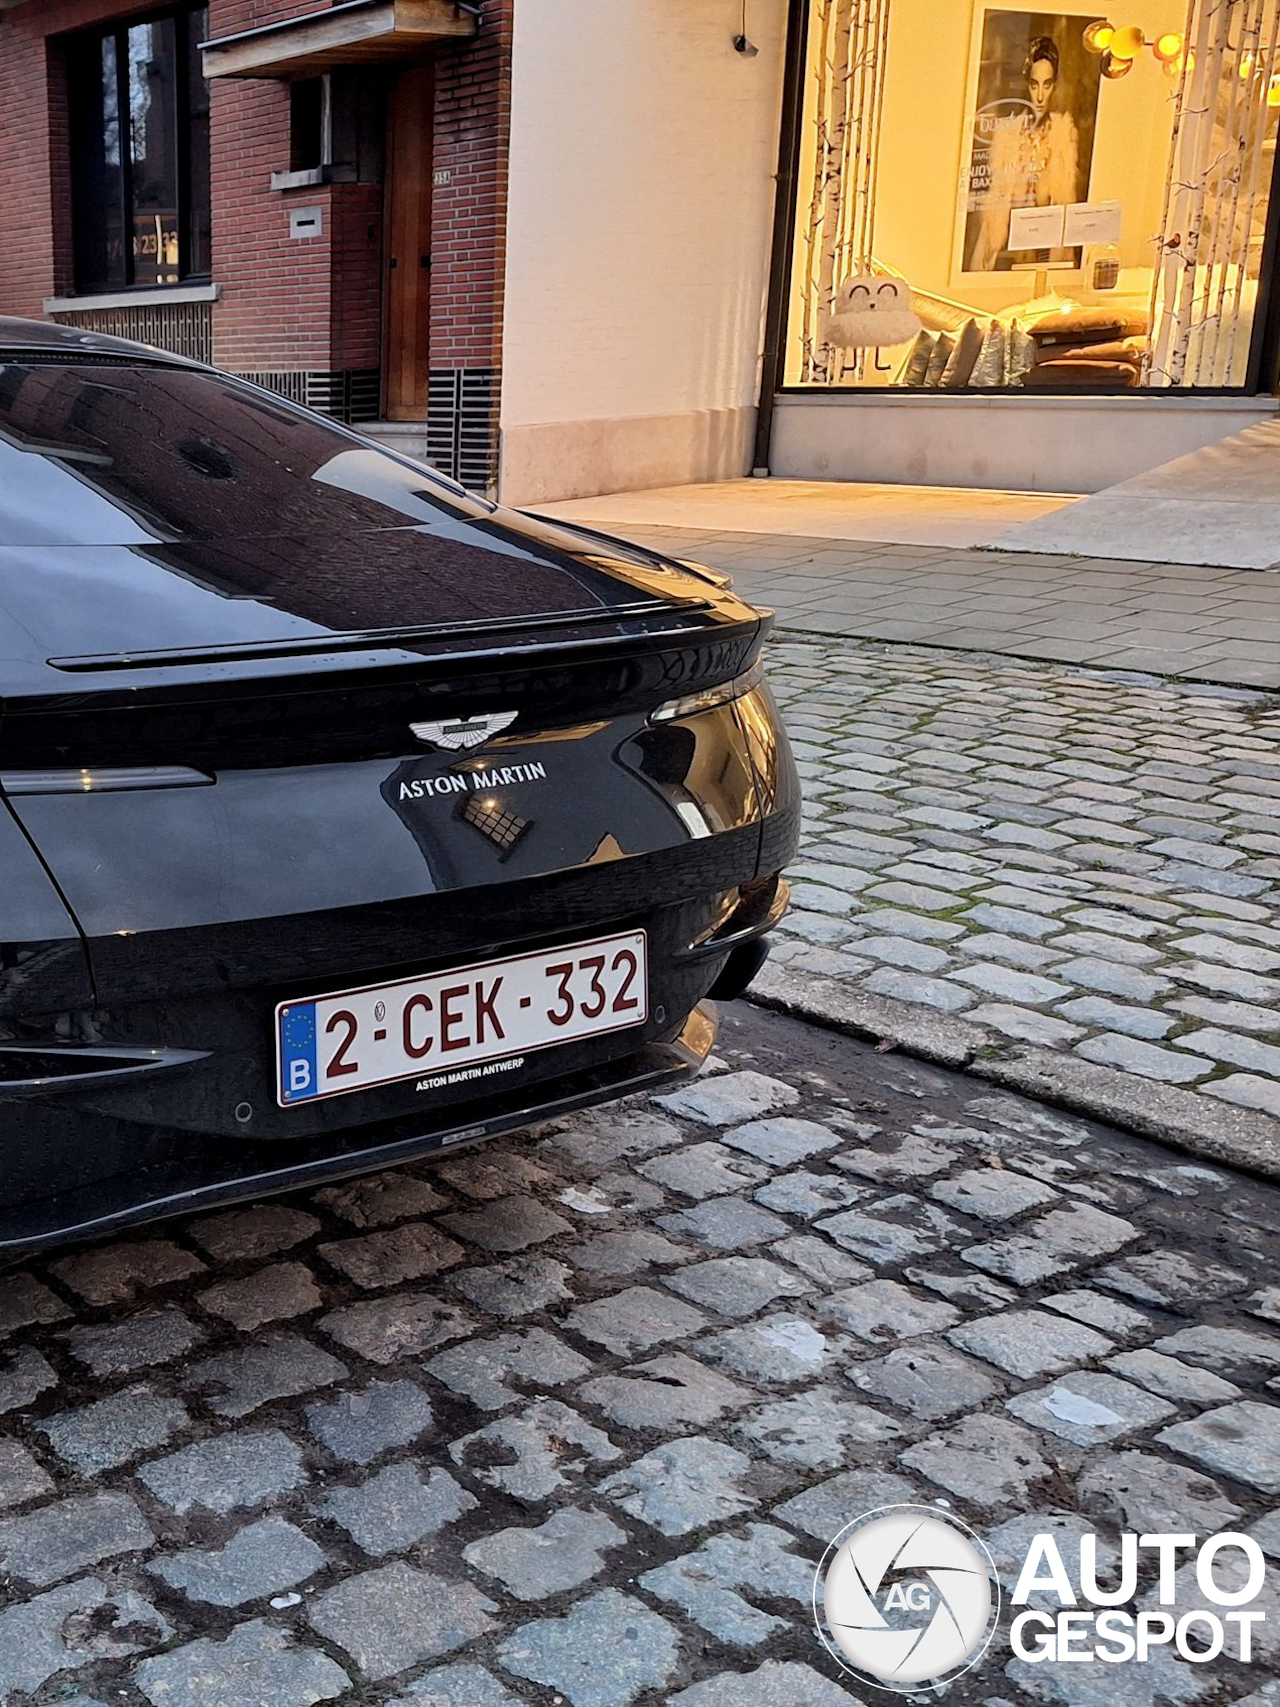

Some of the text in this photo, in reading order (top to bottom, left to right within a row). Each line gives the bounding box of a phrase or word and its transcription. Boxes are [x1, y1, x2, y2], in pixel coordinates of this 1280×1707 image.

[399, 761, 547, 800] ASTON MARTIN
[325, 949, 638, 1078] 2-CEK-332
[289, 1058, 312, 1092] B
[415, 1057, 525, 1092] ASTON MARTIN ANTWERP
